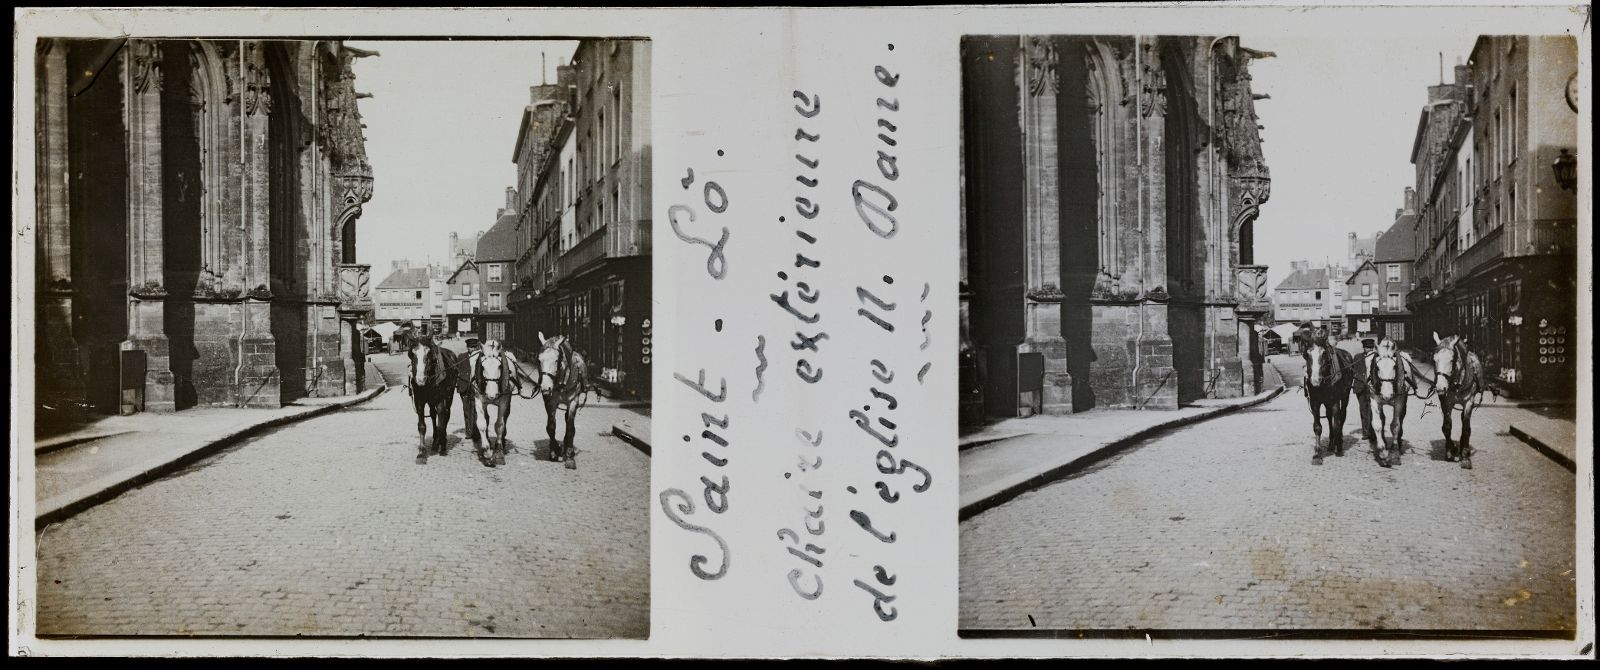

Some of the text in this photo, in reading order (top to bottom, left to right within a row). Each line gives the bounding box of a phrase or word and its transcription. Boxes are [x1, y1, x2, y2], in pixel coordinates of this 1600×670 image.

[769, 90, 830, 383] extérieure
[659, 368, 730, 581] Saint
[853, 565, 898, 622] de
